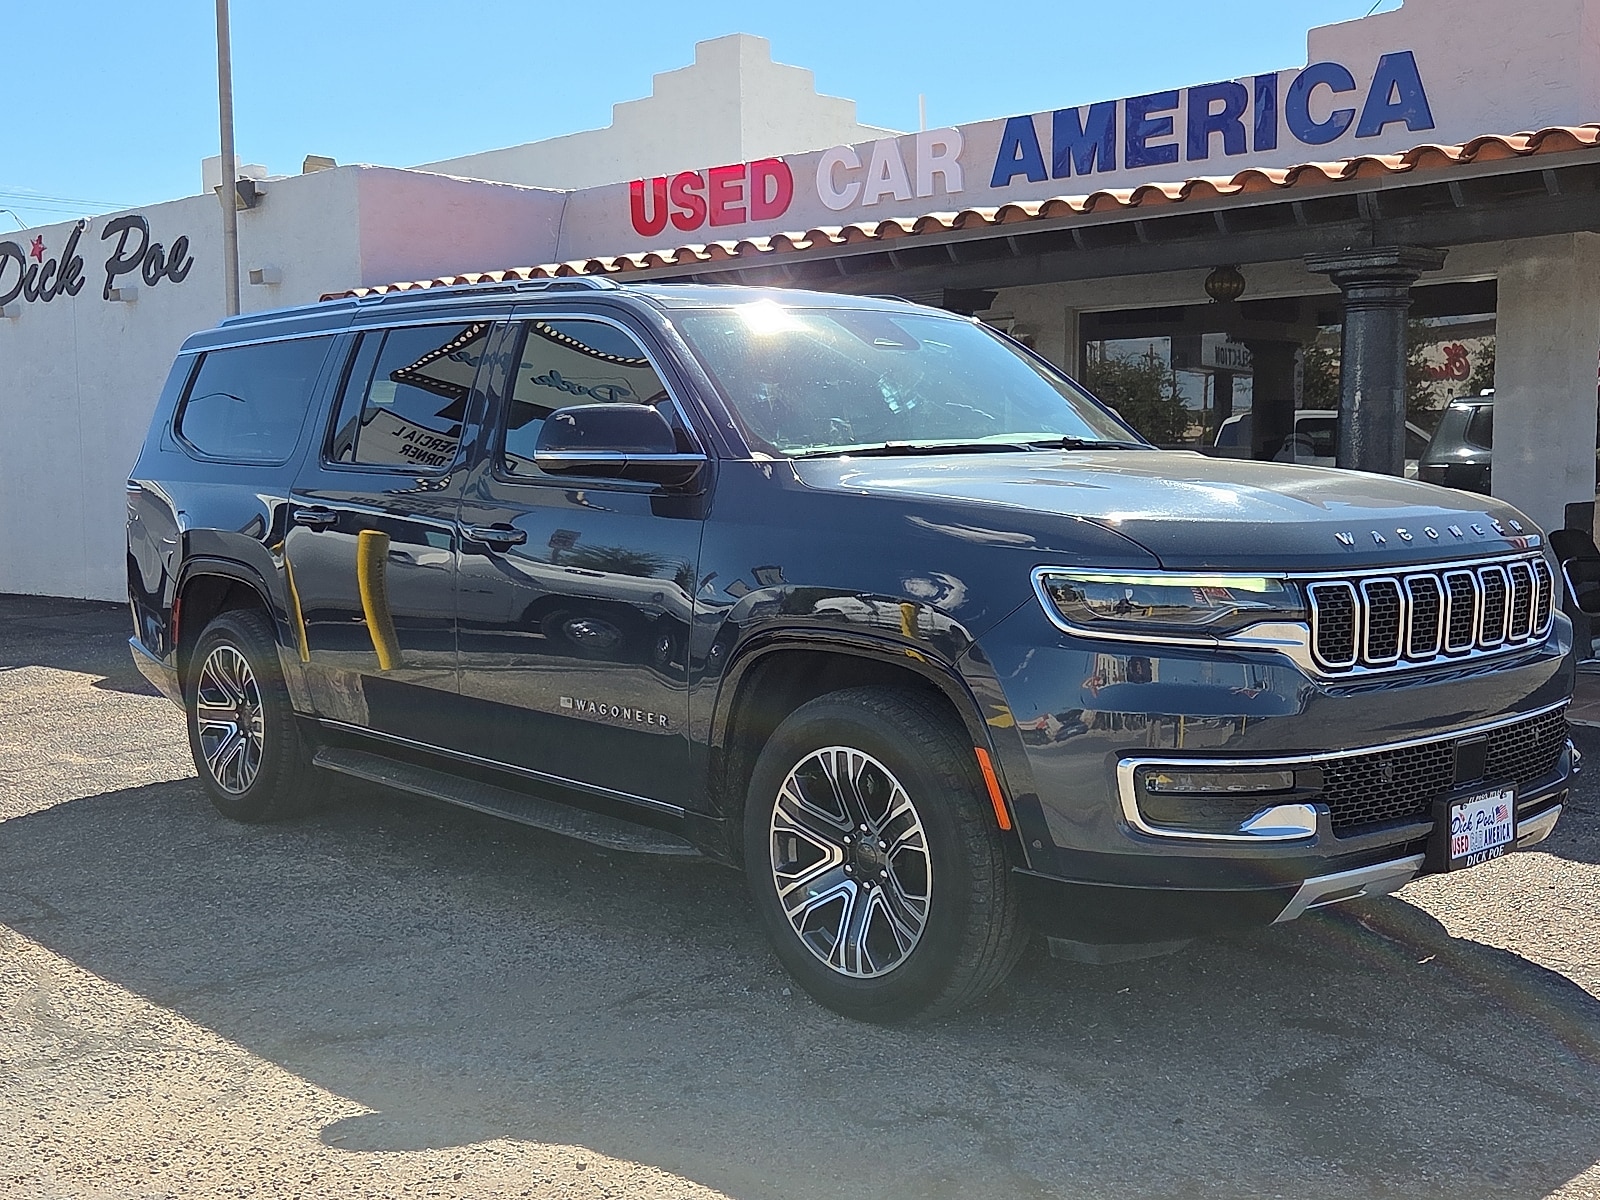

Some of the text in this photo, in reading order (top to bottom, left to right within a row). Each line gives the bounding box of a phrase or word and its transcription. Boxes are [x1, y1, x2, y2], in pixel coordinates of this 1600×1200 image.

[629, 50, 1436, 237] USED CAR AMERICA
[0, 214, 195, 307] Dick Poe
[1335, 519, 1524, 546] WAGONEER
[576, 699, 668, 727] WAGONEER
[1451, 813, 1473, 835] Dick
[1452, 835, 1469, 856] USED
[1484, 823, 1510, 846] AMERICA
[1466, 845, 1505, 867] DICK POE
